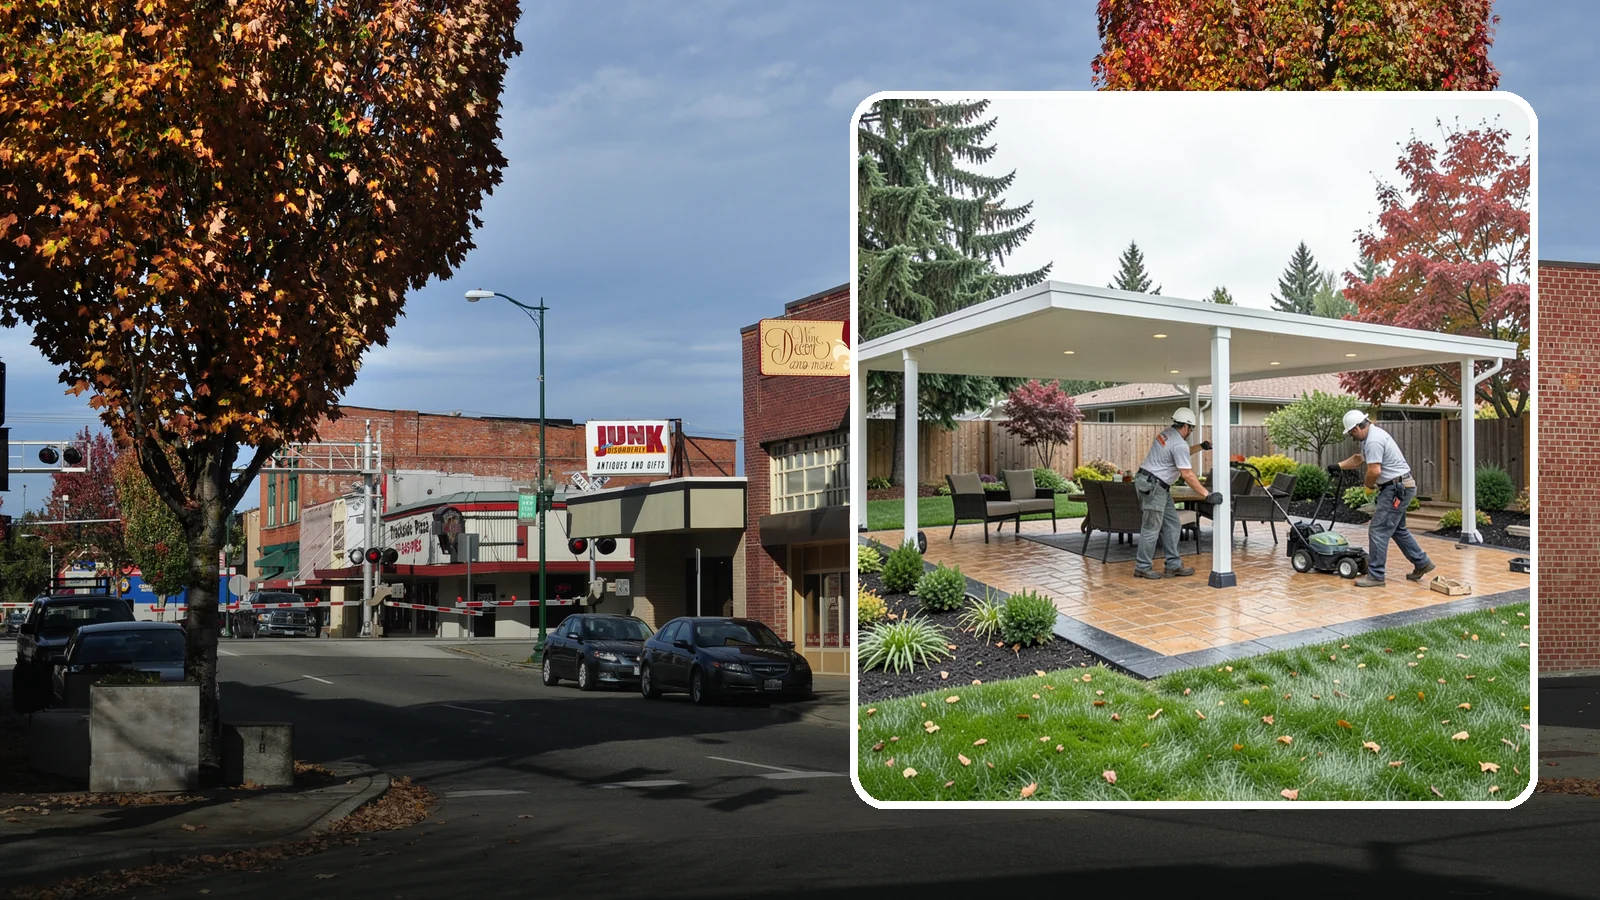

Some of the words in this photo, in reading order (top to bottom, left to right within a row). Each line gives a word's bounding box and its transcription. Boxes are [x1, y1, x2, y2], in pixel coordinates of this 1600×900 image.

[595, 425, 665, 457] JUNK
[608, 446, 645, 454] DISORDERLY
[597, 461, 628, 470] ANTIQUES
[631, 461, 643, 470] AND
[647, 460, 665, 470] GIFTS
[590, 476, 608, 491] SING
[414, 519, 429, 535] Pizza
